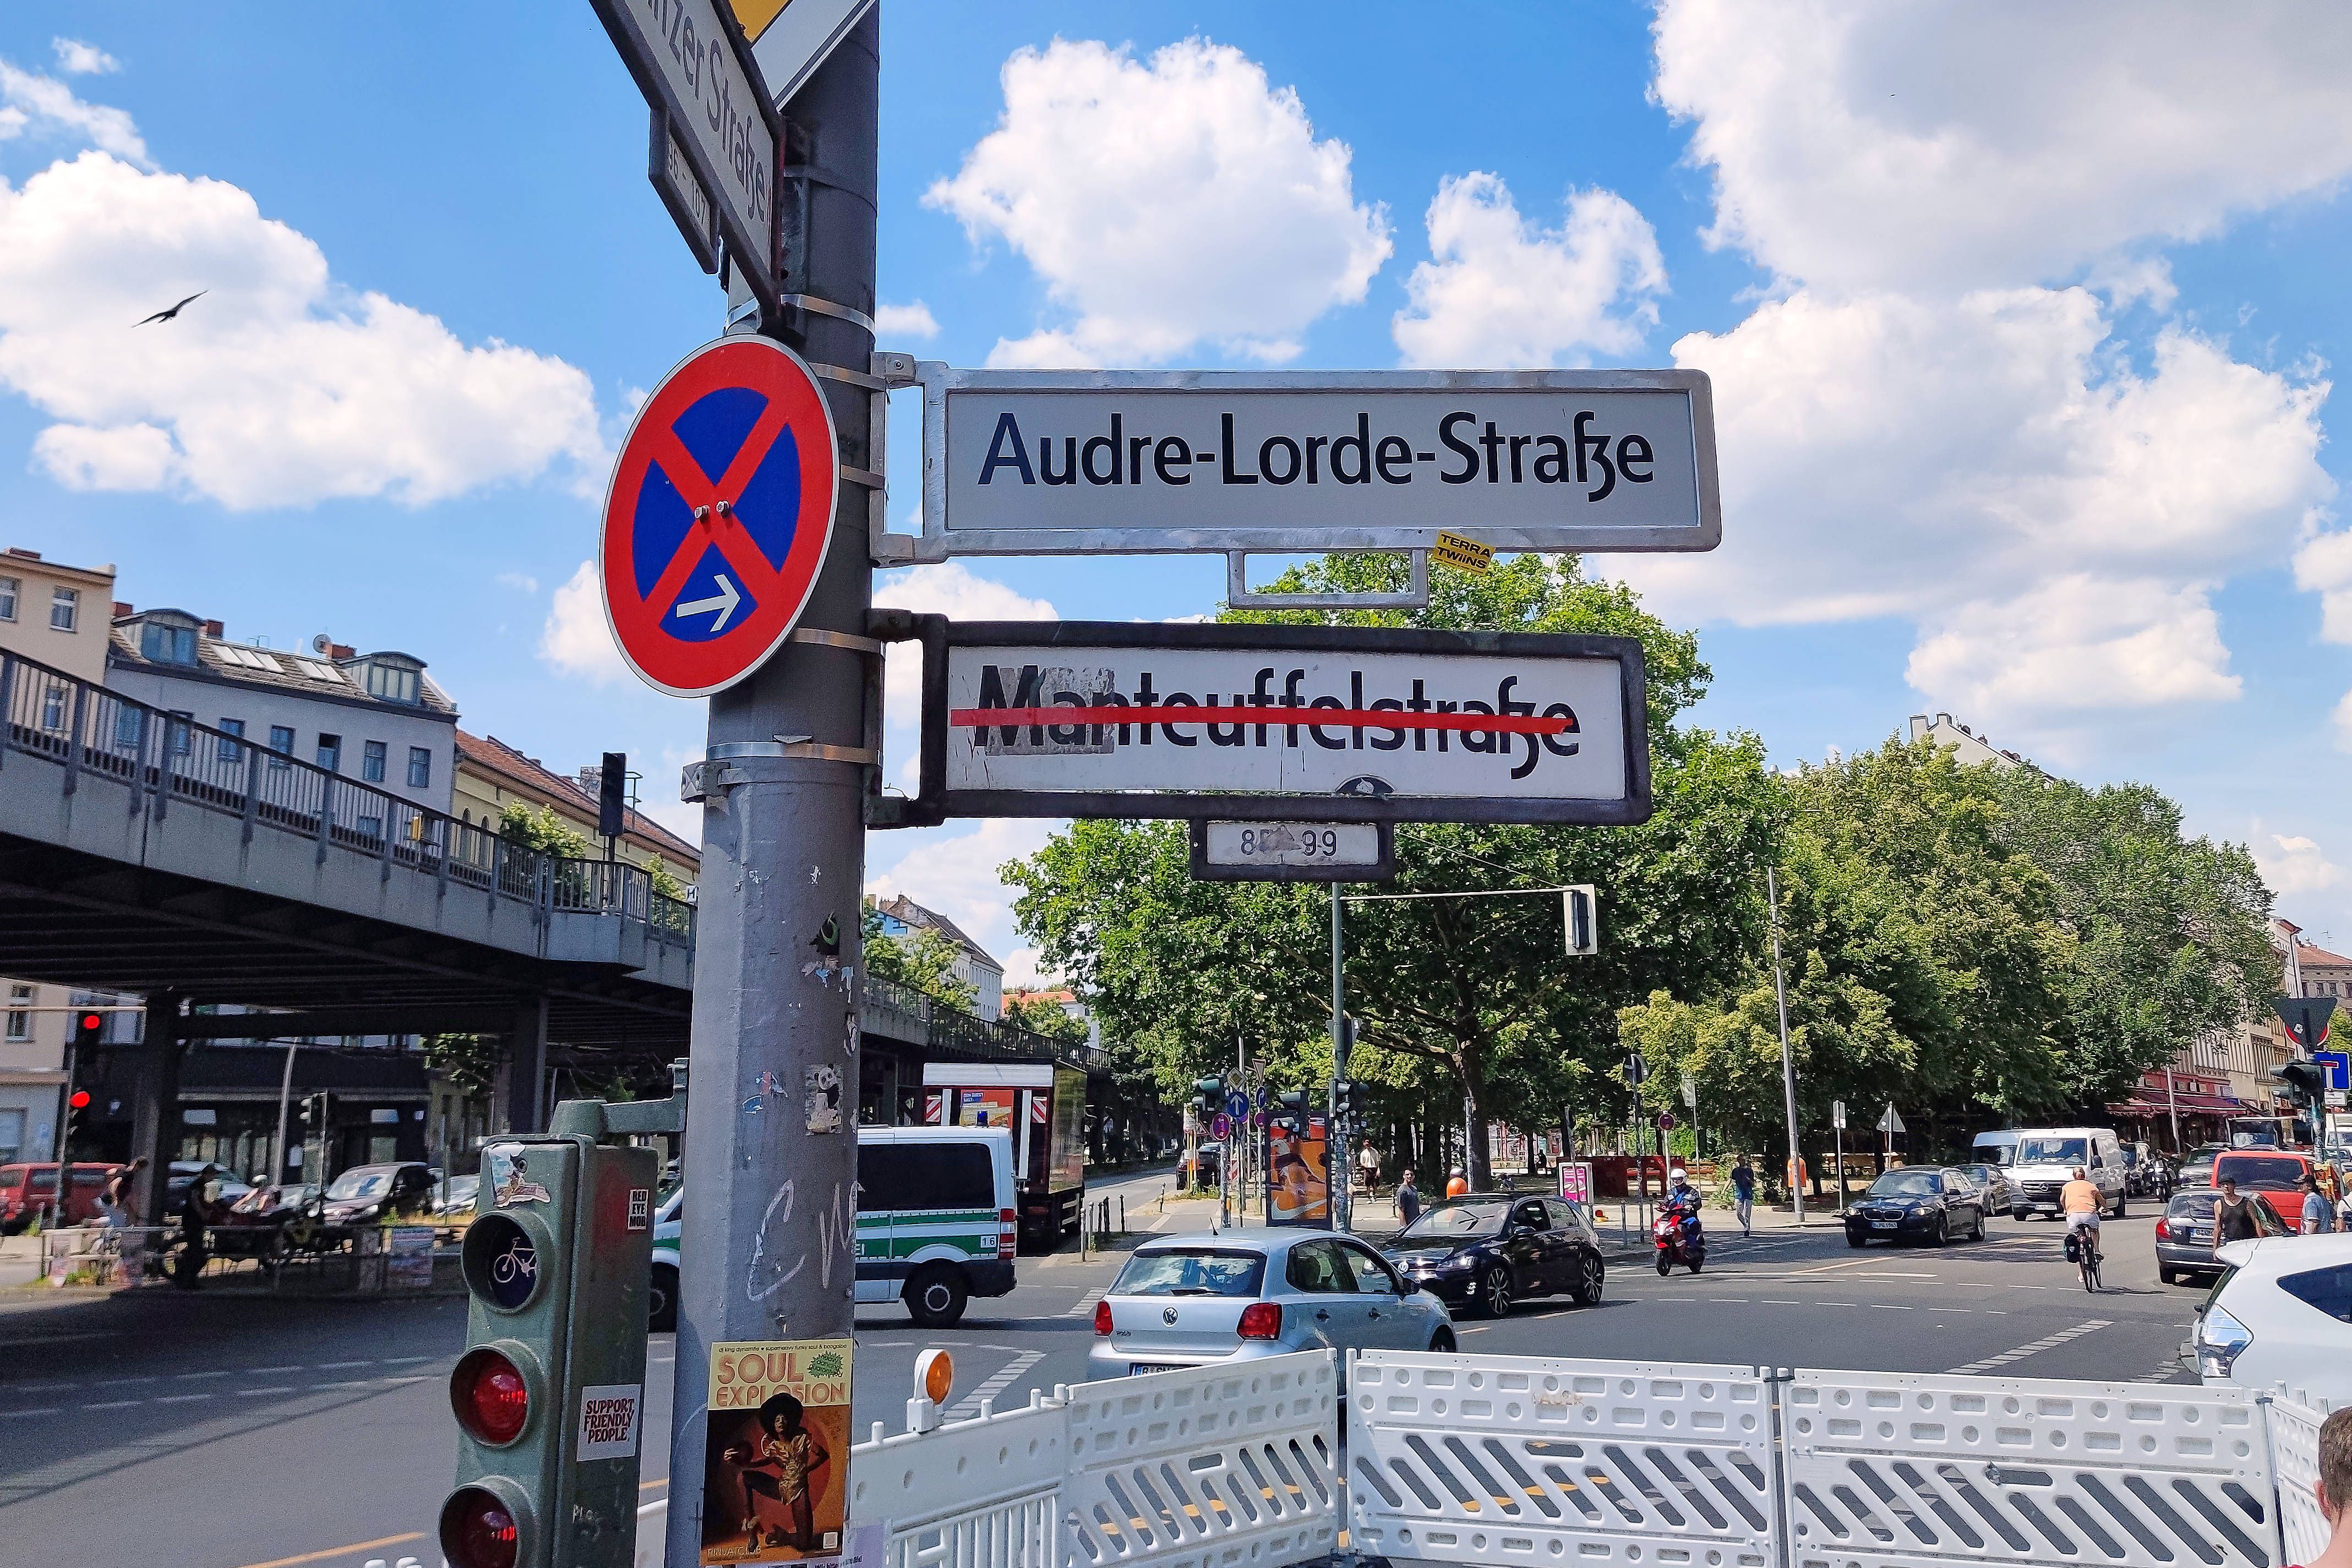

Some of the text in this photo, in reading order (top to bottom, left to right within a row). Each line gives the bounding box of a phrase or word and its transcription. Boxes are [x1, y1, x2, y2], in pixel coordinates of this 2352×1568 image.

[707, 39, 766, 222] Straße
[977, 409, 1655, 503] Audre-Lorde-Straße
[1441, 533, 1491, 558] TERRA
[974, 664, 1580, 780] Manteuffelstraße
[718, 1353, 804, 1384] SOUL
[583, 1409, 635, 1432] FRIENDLY
[586, 1398, 635, 1414] SUPPORT
